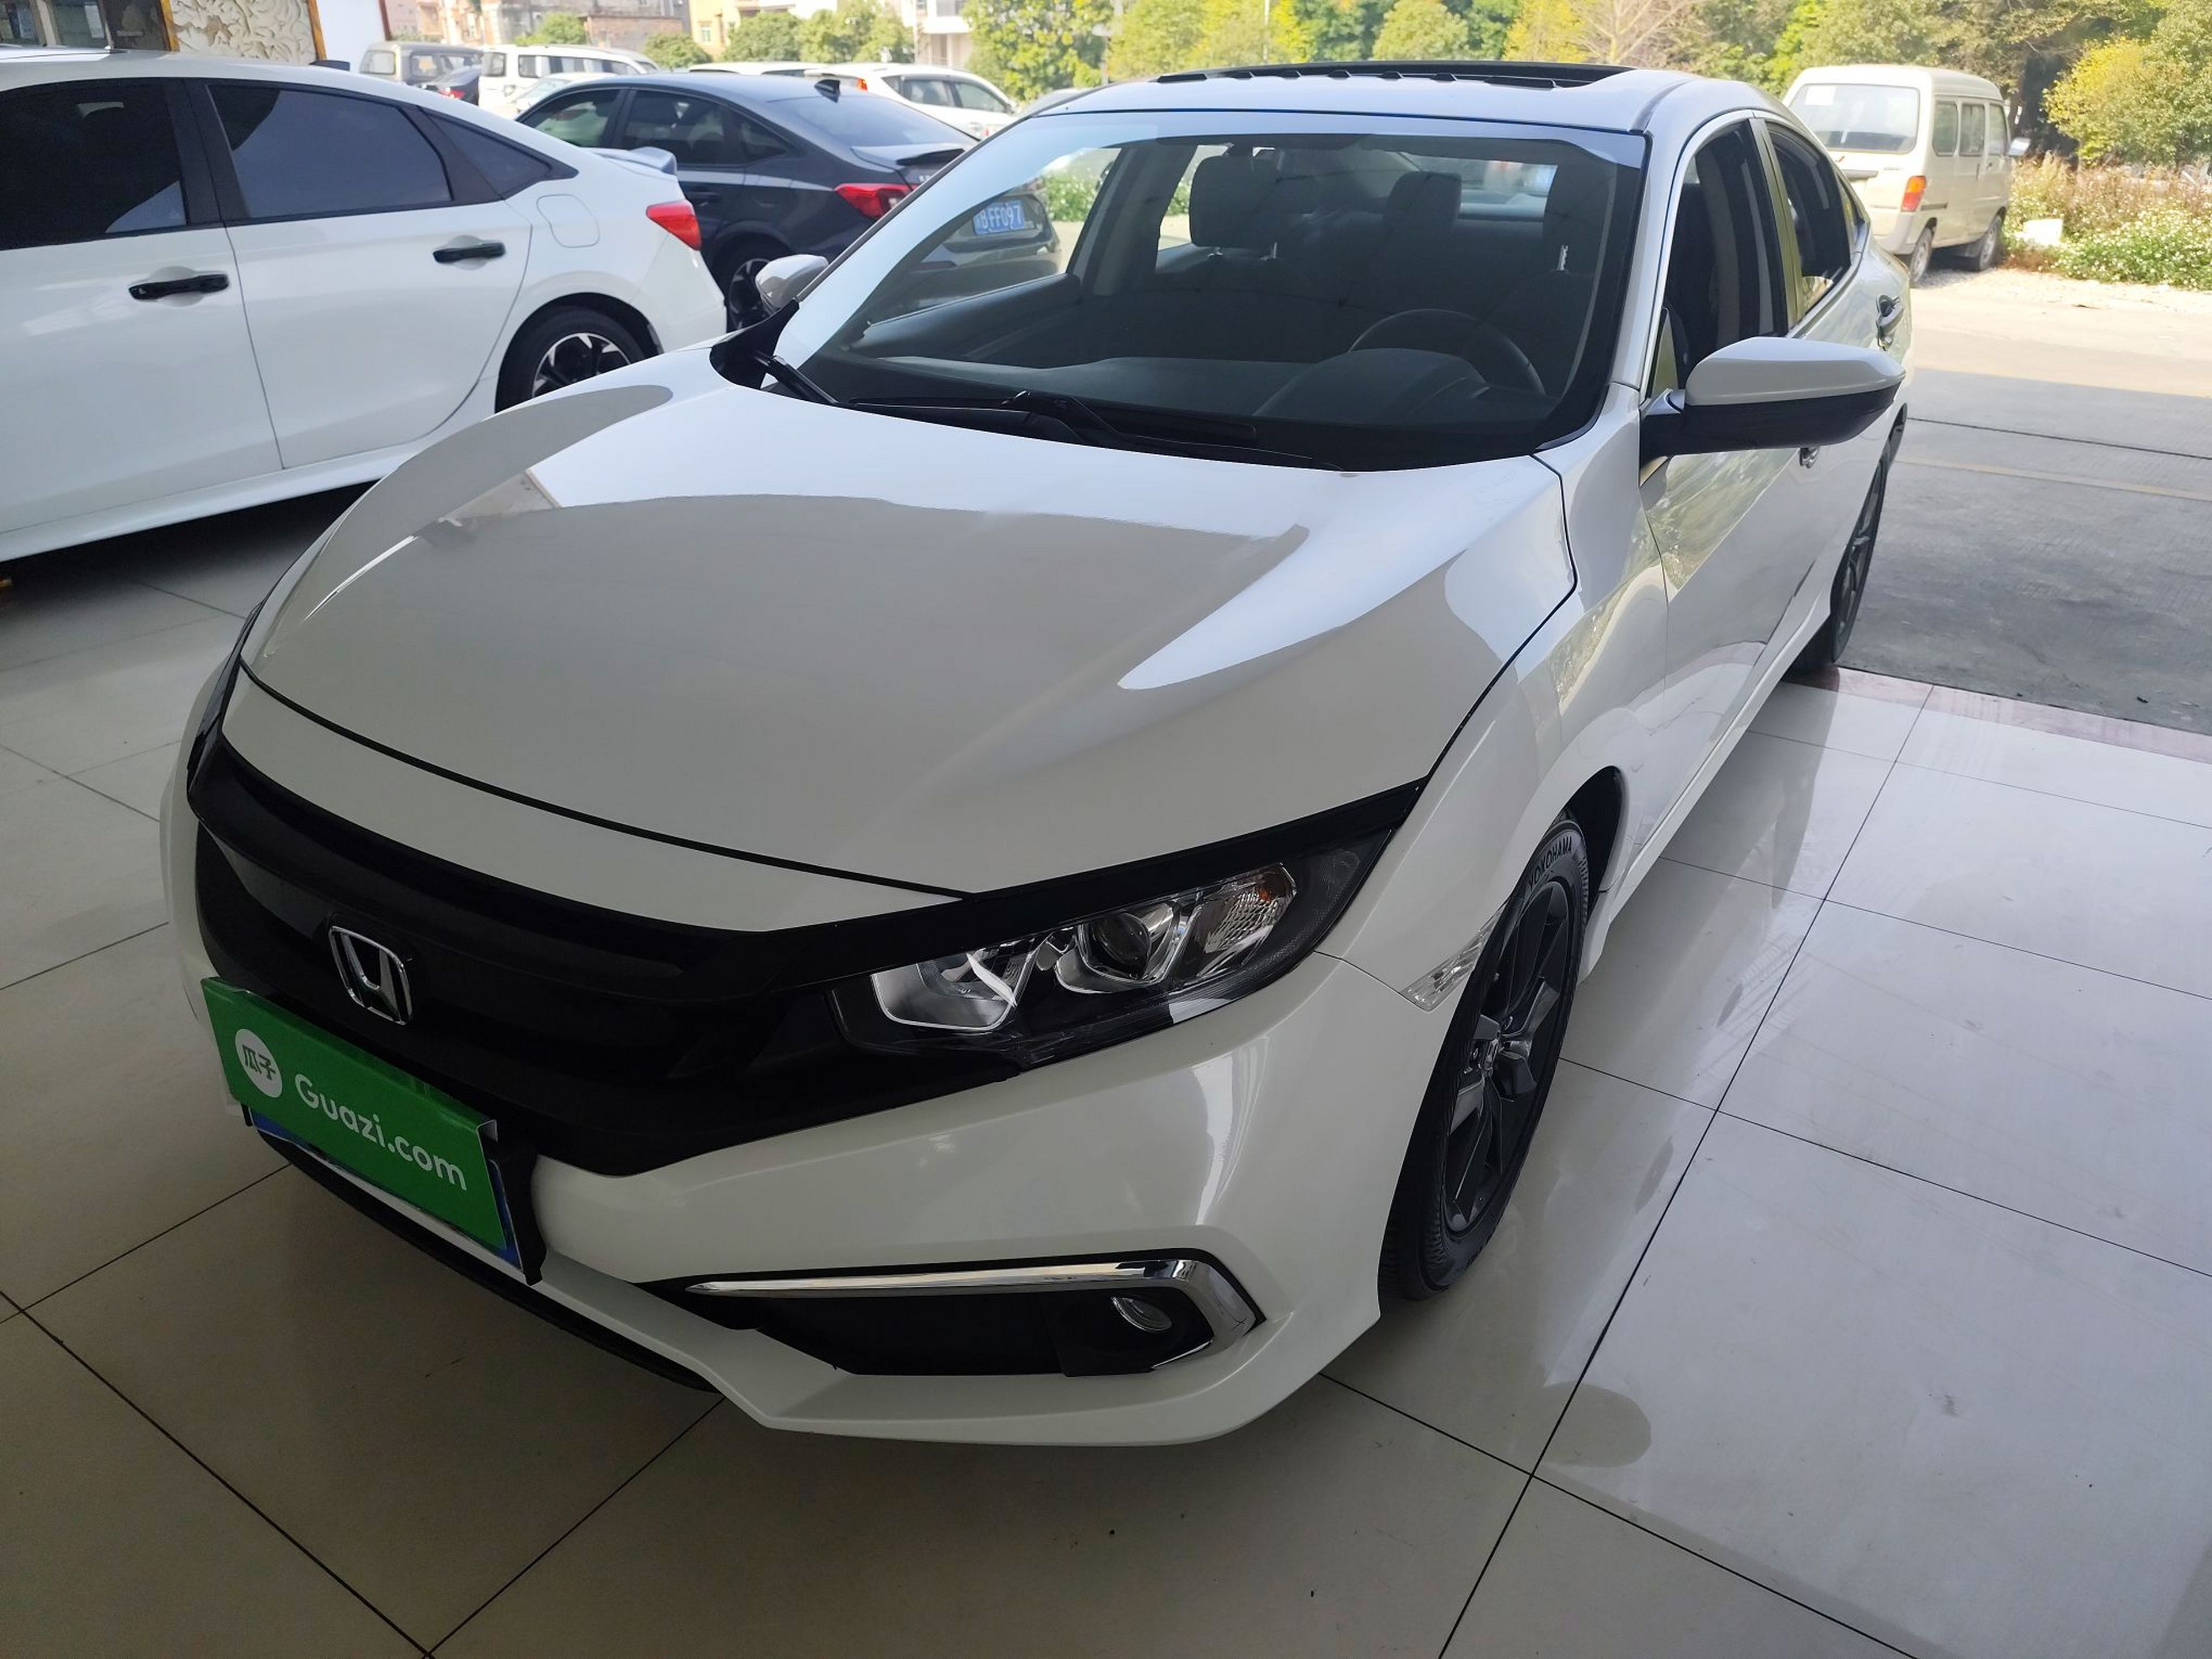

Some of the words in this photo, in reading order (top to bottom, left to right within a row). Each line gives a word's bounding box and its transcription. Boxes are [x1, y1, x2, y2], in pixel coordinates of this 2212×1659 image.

[975, 205, 1022, 229] BFF097
[242, 1044, 276, 1081] 瓜子
[294, 1074, 467, 1191] Guazi.com
